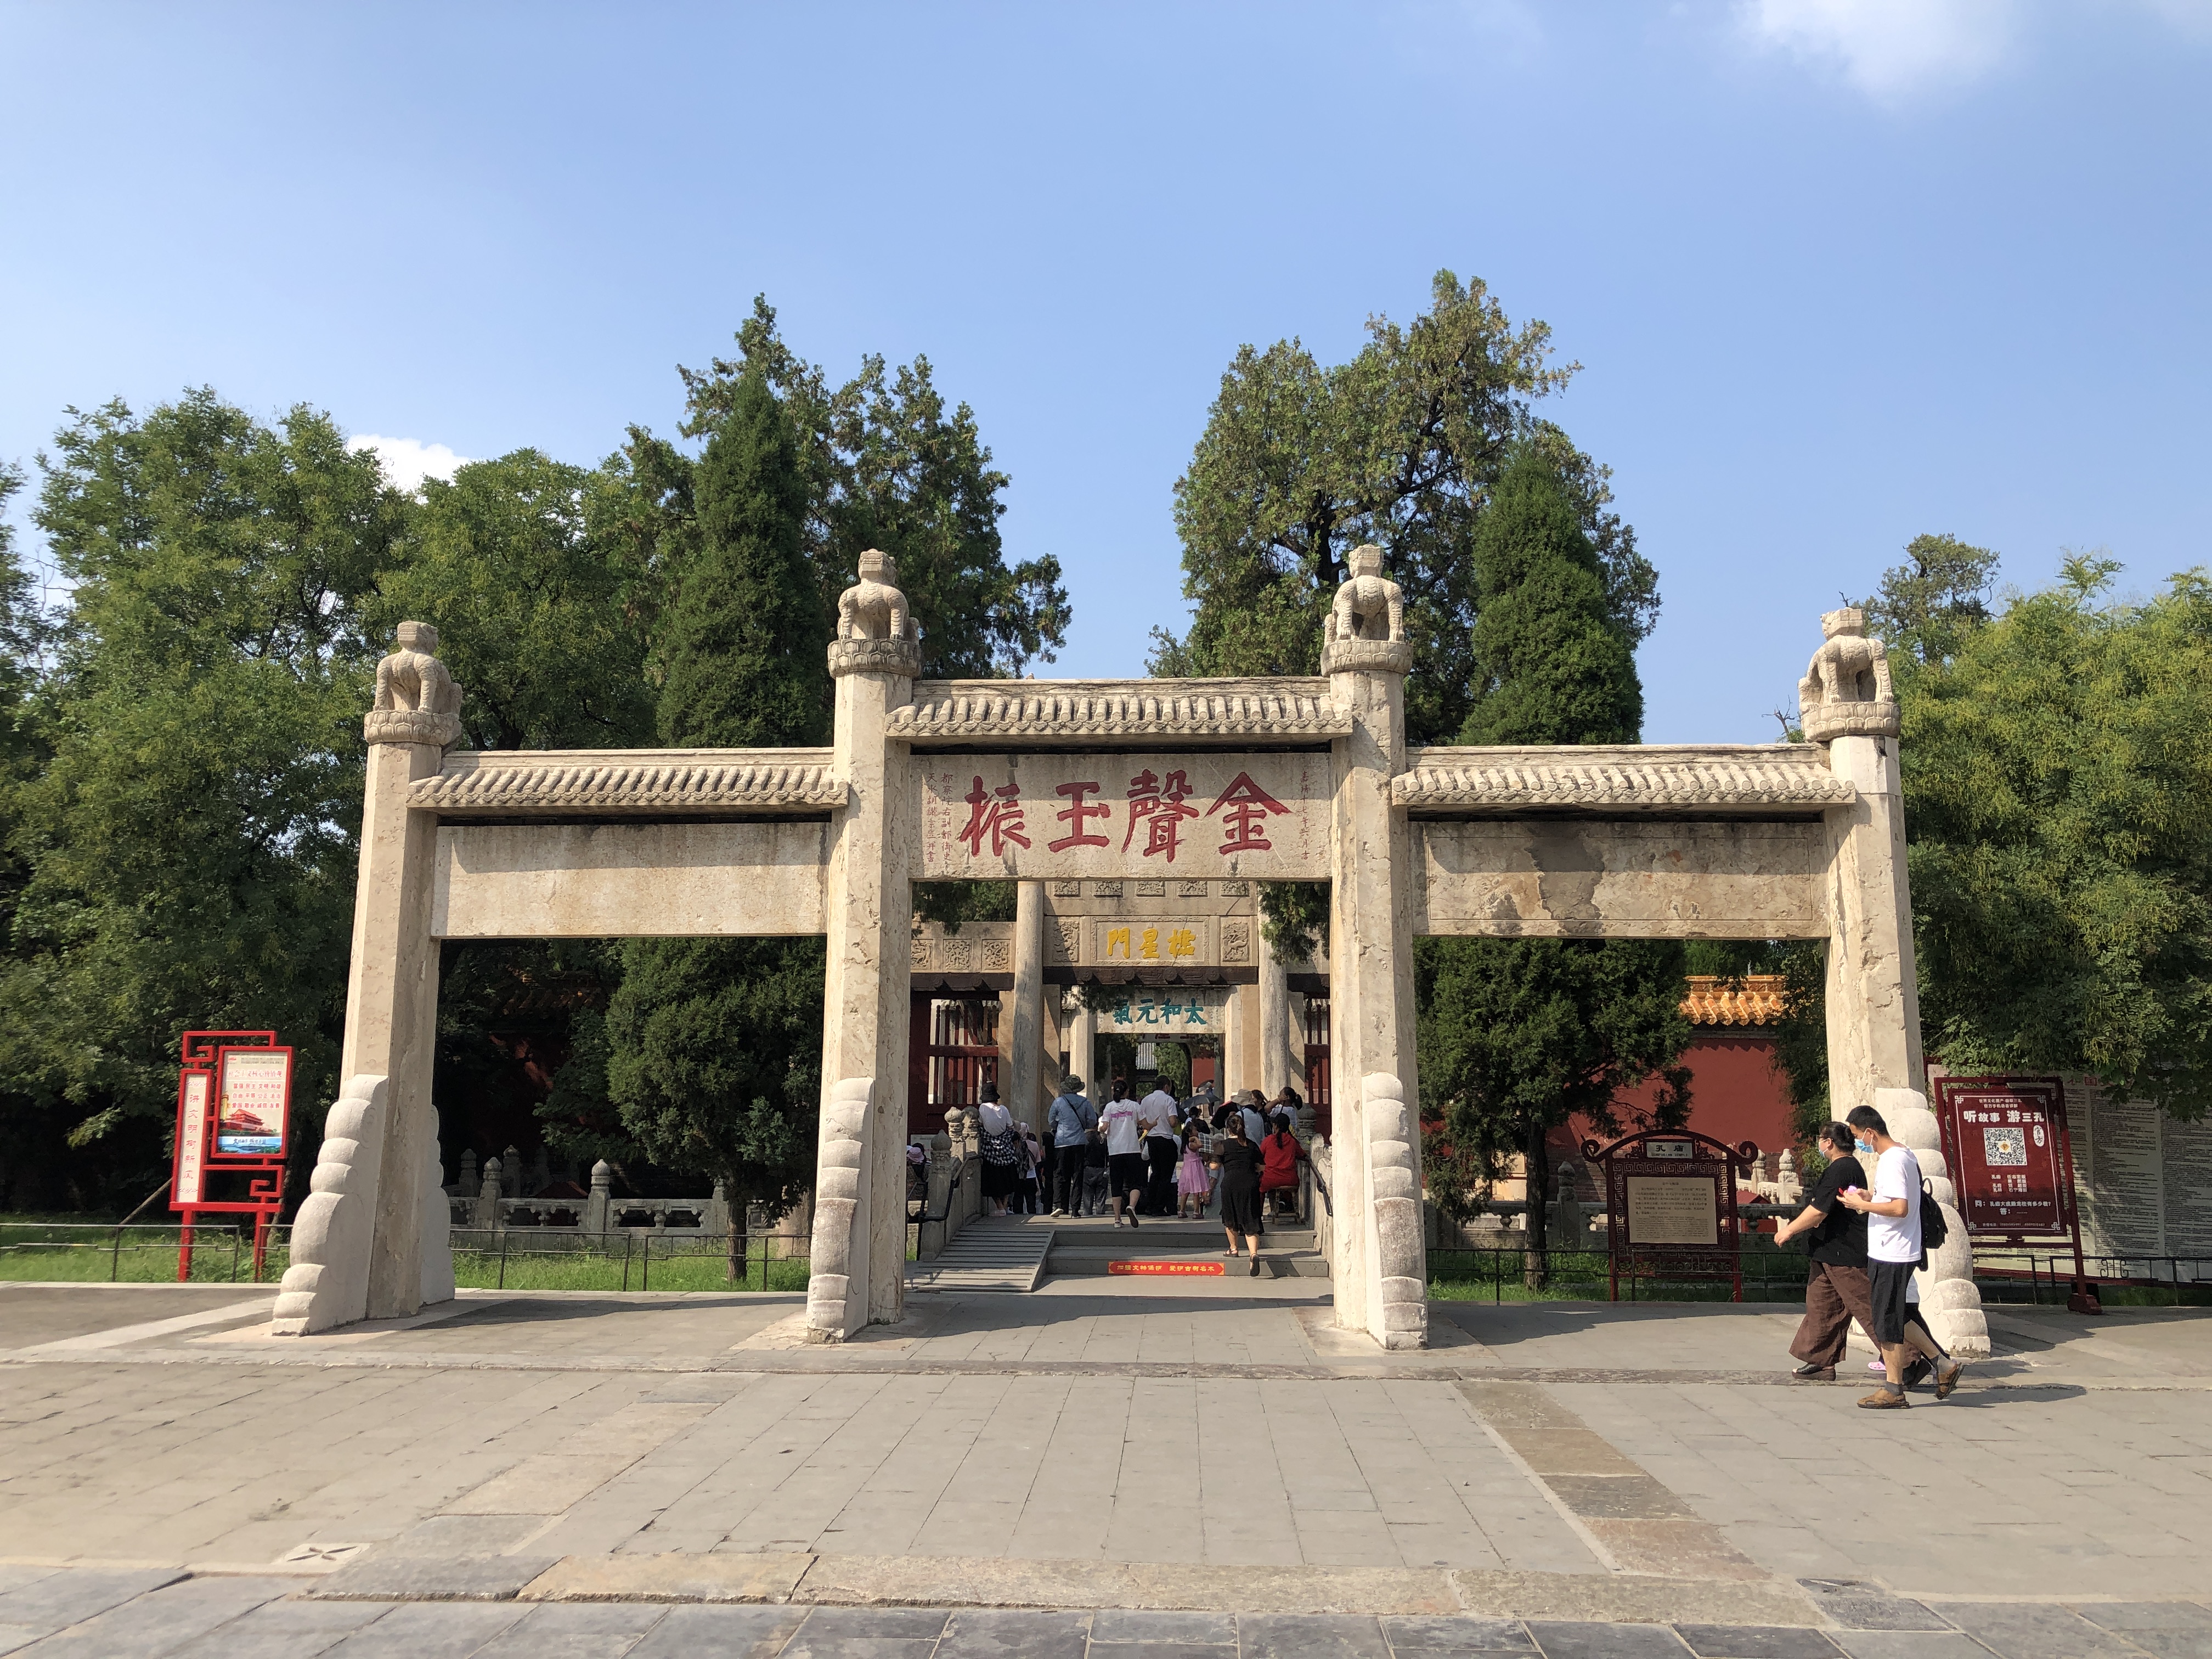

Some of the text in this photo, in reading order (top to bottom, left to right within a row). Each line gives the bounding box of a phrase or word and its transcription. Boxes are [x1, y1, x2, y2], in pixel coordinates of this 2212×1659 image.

[959, 769, 1293, 863] 金聲玉振
[183, 1094, 200, 1179] 讲文明树新风
[1963, 1110, 2045, 1123] 听故事 游三孔
[2034, 1126, 2043, 1144] 官方
